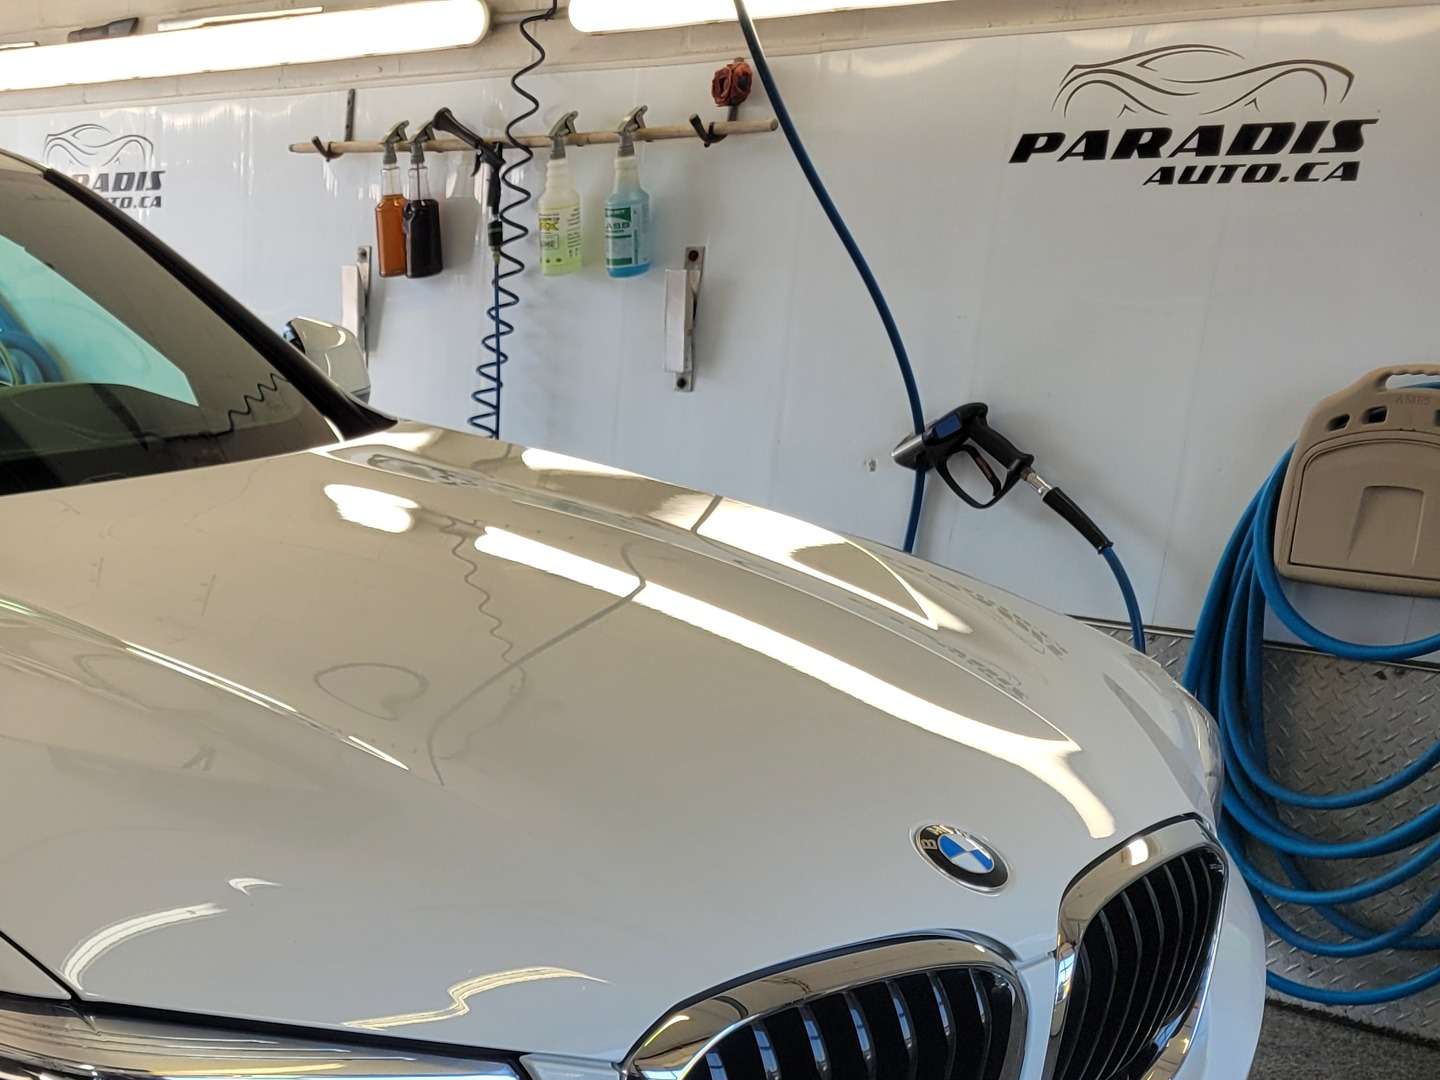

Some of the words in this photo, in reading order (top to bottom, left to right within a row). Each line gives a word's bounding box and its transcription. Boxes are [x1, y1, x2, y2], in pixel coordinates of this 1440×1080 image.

[1008, 118, 1379, 164] PARADIS
[71, 171, 166, 193] RADIS
[1143, 161, 1360, 186] AUTO.CA
[105, 195, 162, 209] TO.CA
